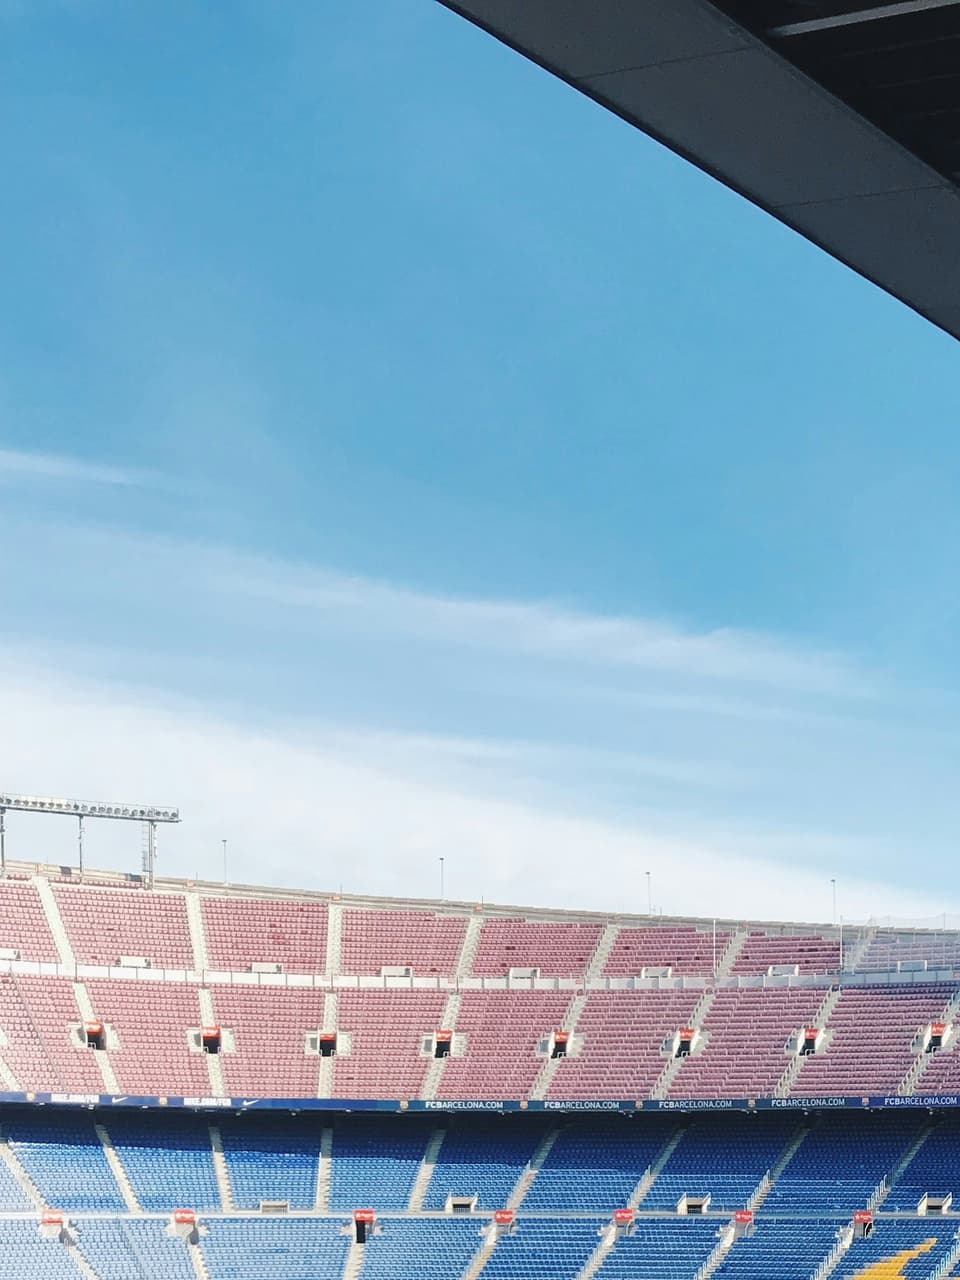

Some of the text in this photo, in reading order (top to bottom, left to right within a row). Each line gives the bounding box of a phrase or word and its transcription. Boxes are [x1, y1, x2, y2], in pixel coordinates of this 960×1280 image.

[425, 1101, 503, 1109] FCBARCELONA.COM
[544, 1101, 620, 1109] FCBARCELONA.COM
[659, 1100, 732, 1109] FCBARCELONA.COM
[771, 1098, 845, 1107] FCBARCELONA.COM
[884, 1097, 957, 1105] FCBARCELONA.COM
